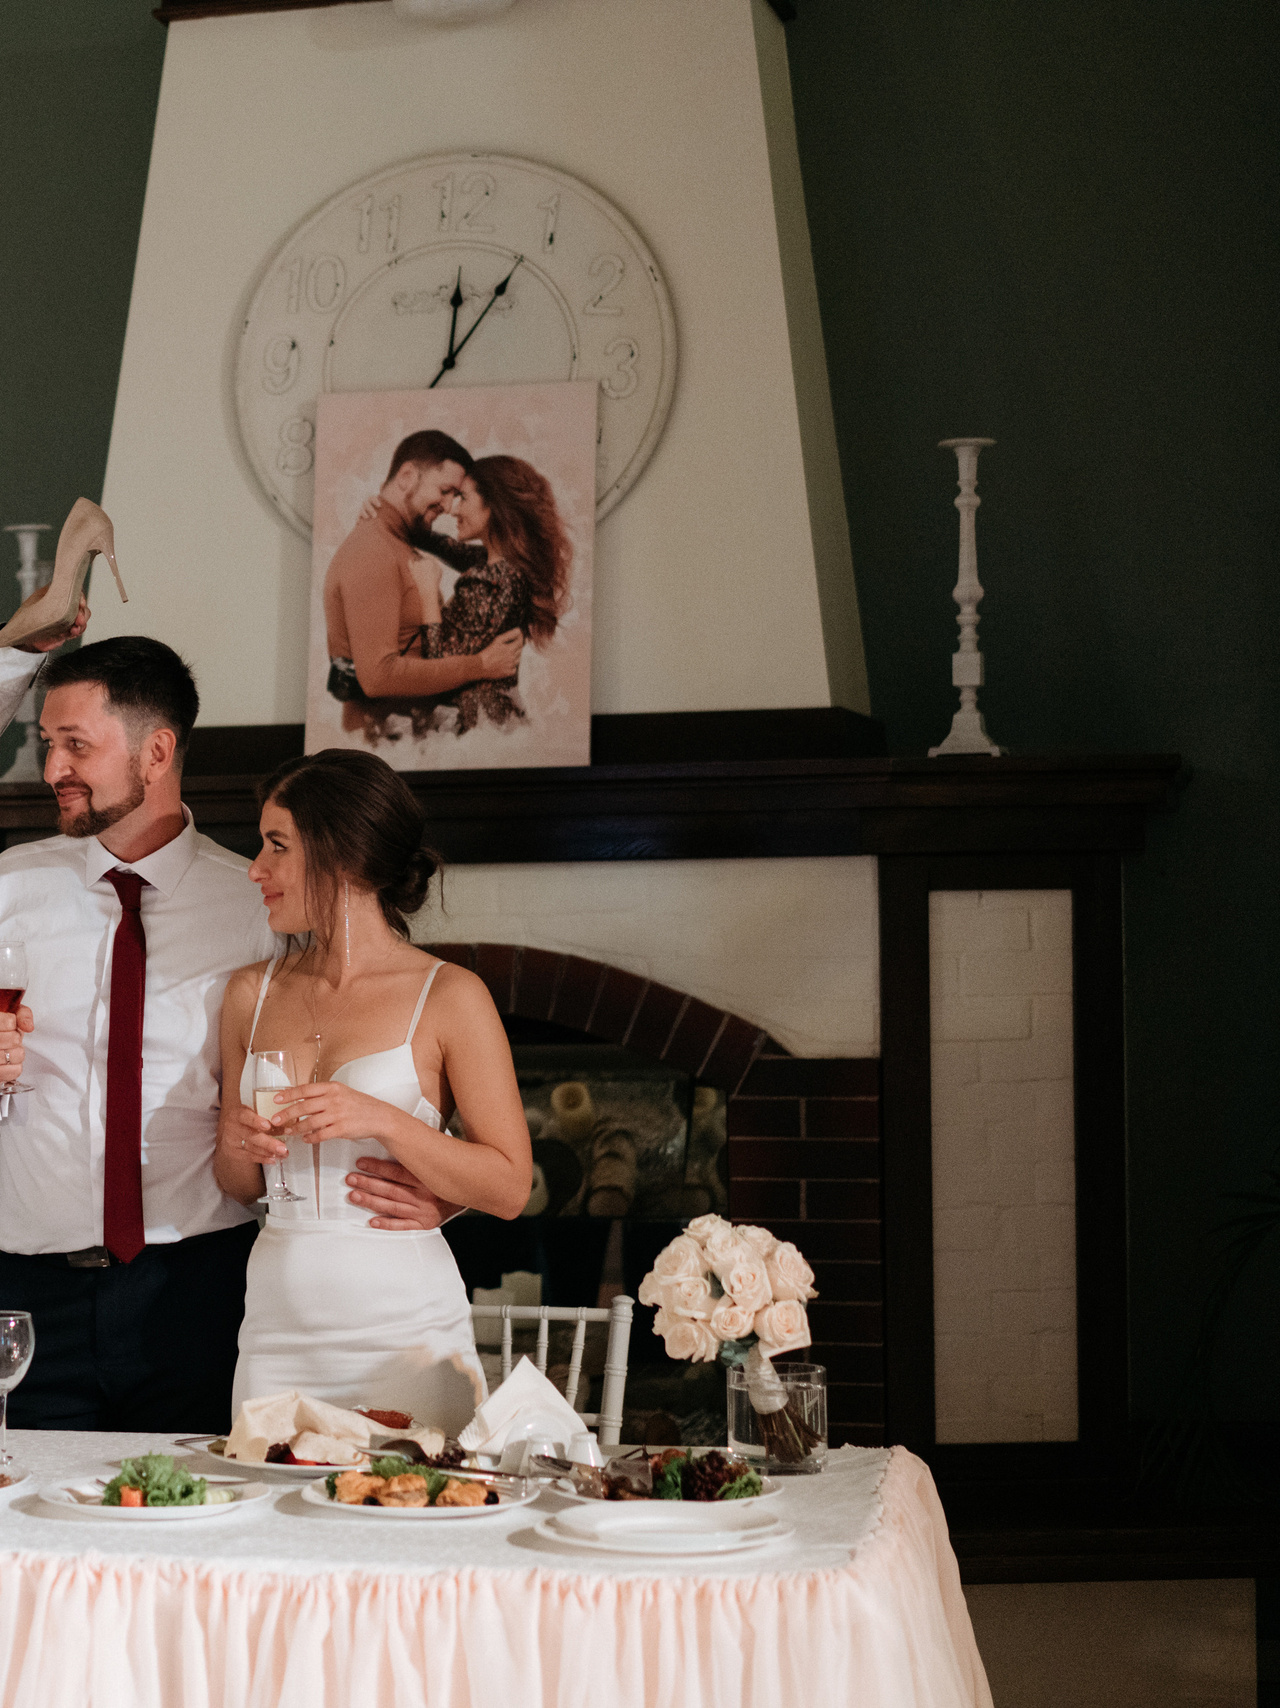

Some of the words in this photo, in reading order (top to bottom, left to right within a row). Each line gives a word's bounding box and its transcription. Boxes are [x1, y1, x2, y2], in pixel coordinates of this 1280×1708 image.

[355, 194, 401, 254] 11
[432, 171, 497, 233] 12
[537, 193, 562, 253] 1
[281, 253, 346, 314] 10
[584, 253, 625, 316] 2
[261, 336, 300, 395] 9
[601, 337, 639, 399] 3
[276, 417, 315, 477] 8
